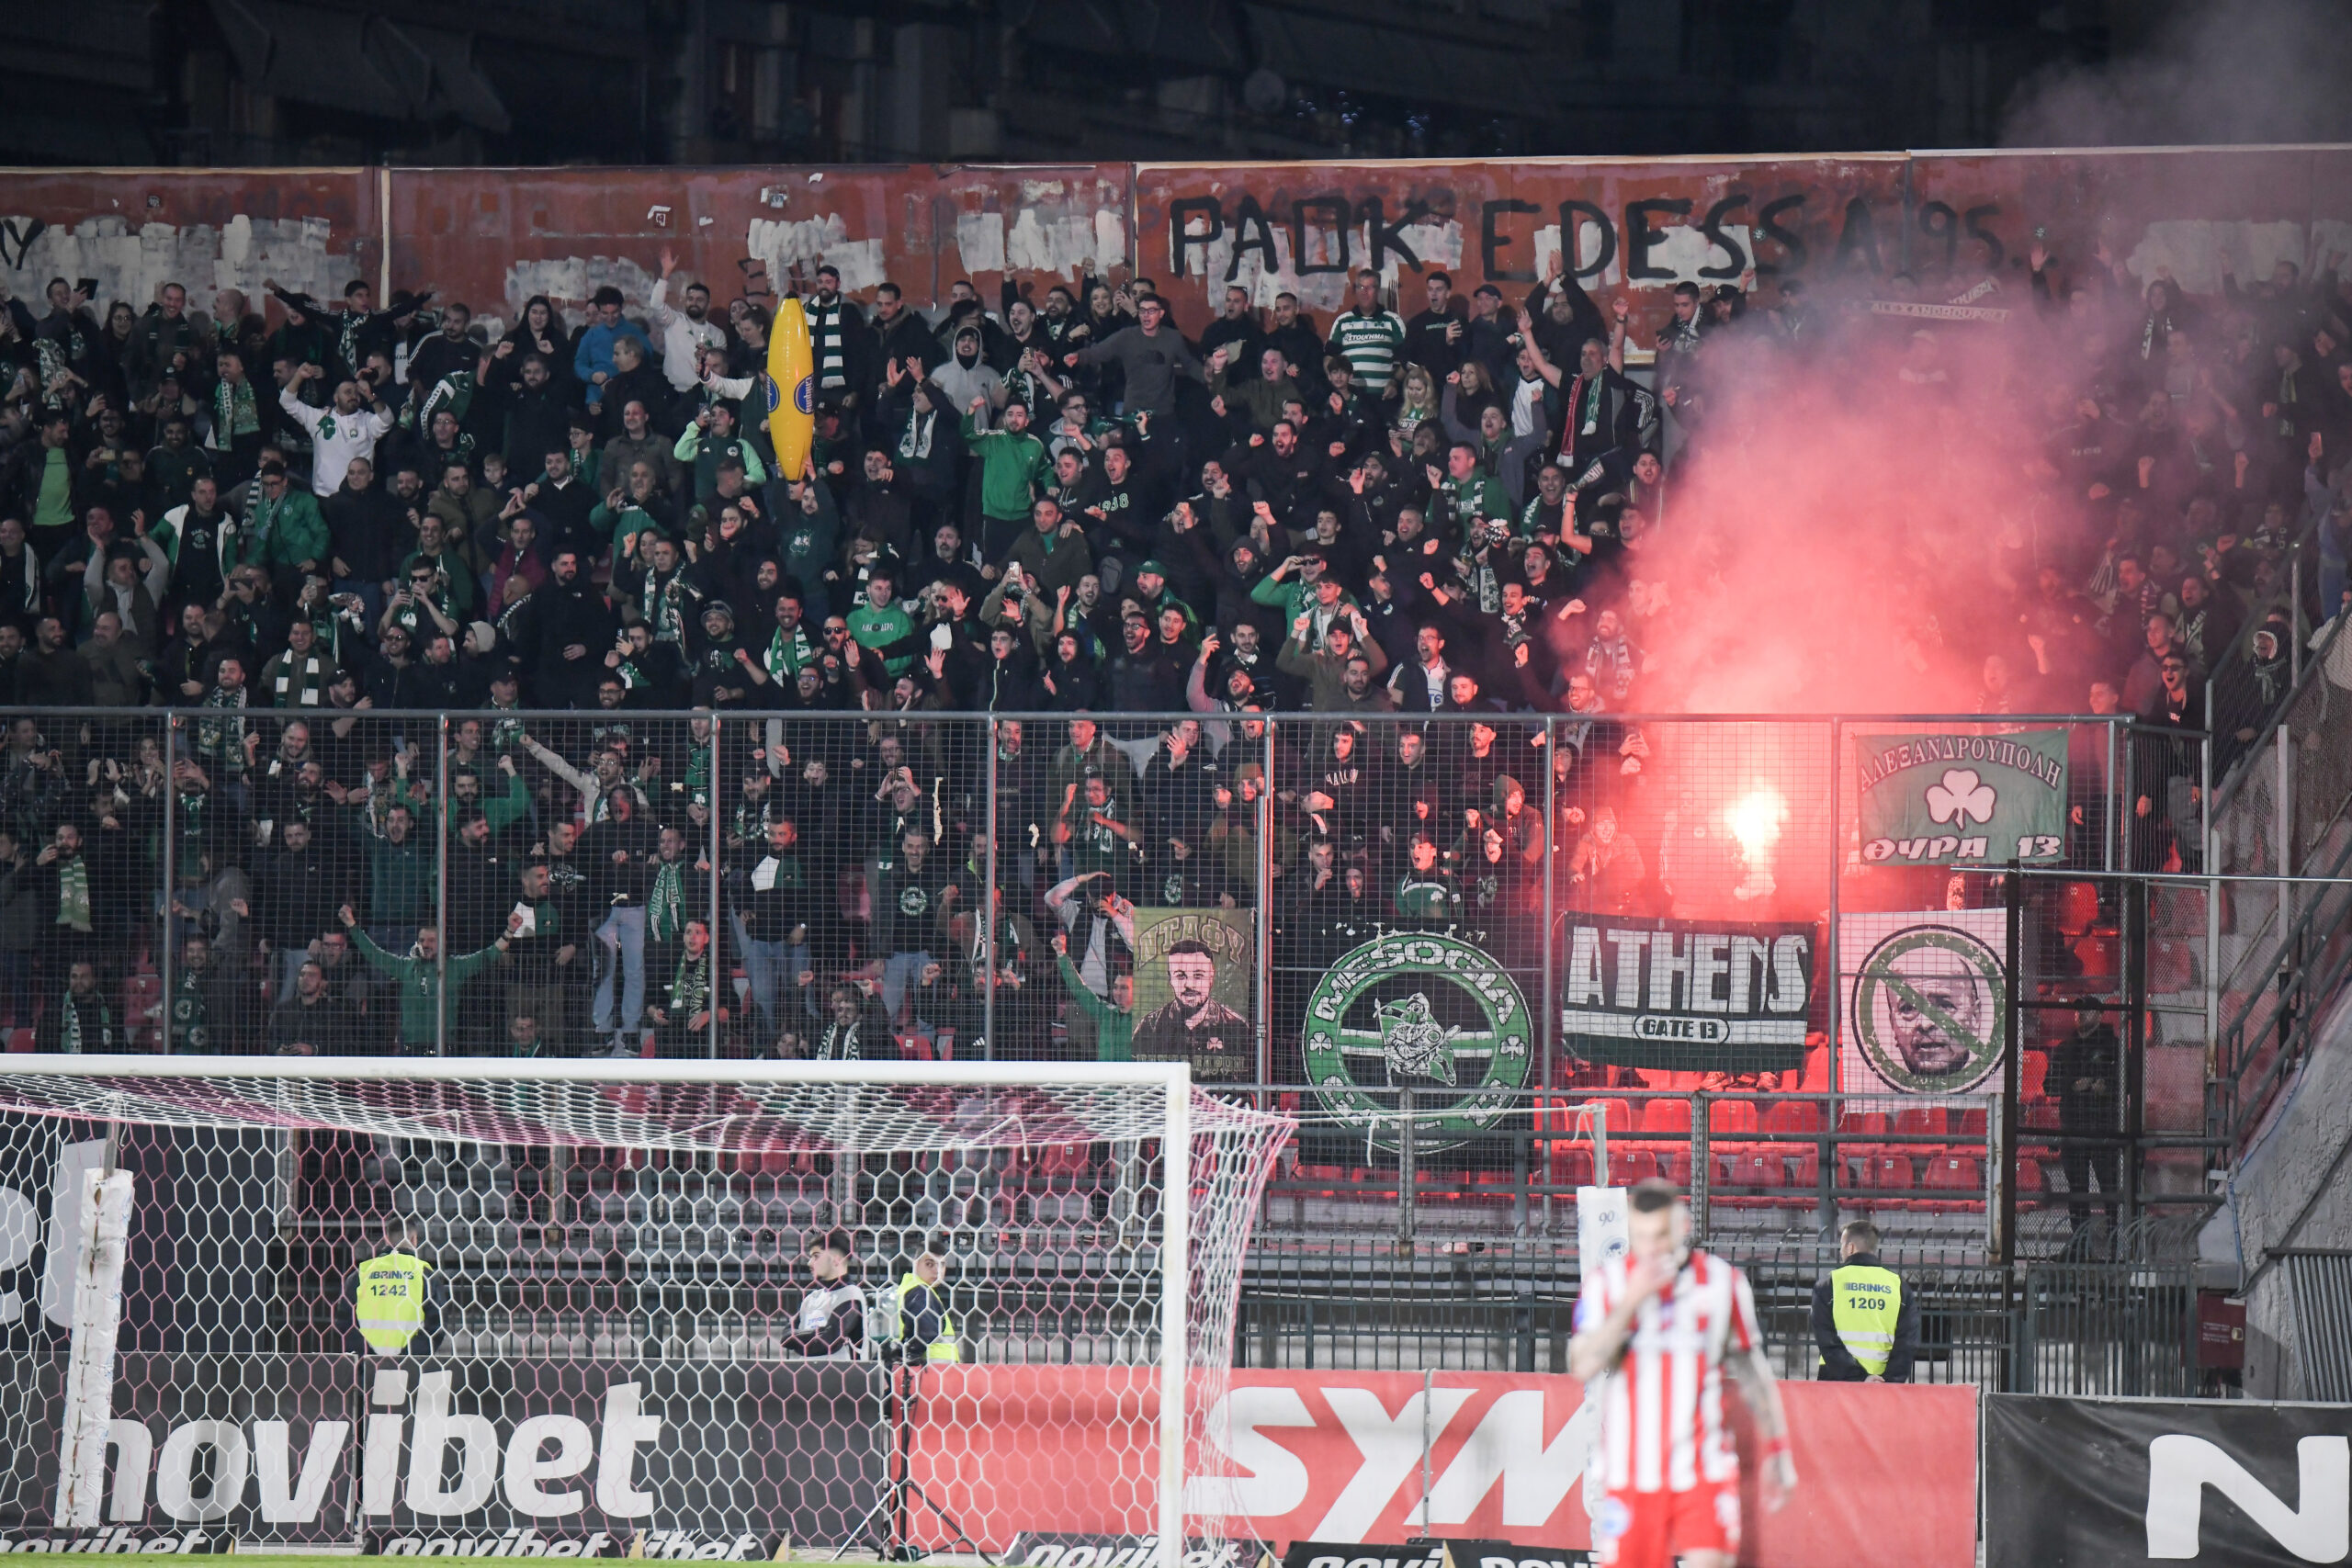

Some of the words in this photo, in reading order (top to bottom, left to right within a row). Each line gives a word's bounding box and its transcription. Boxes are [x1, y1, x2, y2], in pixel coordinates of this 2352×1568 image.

[1170, 194, 1430, 282] PAOK
[1860, 737, 2062, 792] ΑΛΕΞΑΝΔΡΟΥΠΟΛΗ
[1863, 835, 1988, 861] ΘΥΡΑ
[2017, 835, 2061, 858] 13
[1567, 925, 1808, 1014] ATHENS
[1643, 1019, 1694, 1039] GATE
[1700, 1021, 1719, 1040] 13
[370, 1284, 407, 1296] 1242
[1849, 1297, 1885, 1311] 1209
[2145, 1434, 2350, 1563] N
[1023, 1535, 1241, 1568] noviet
